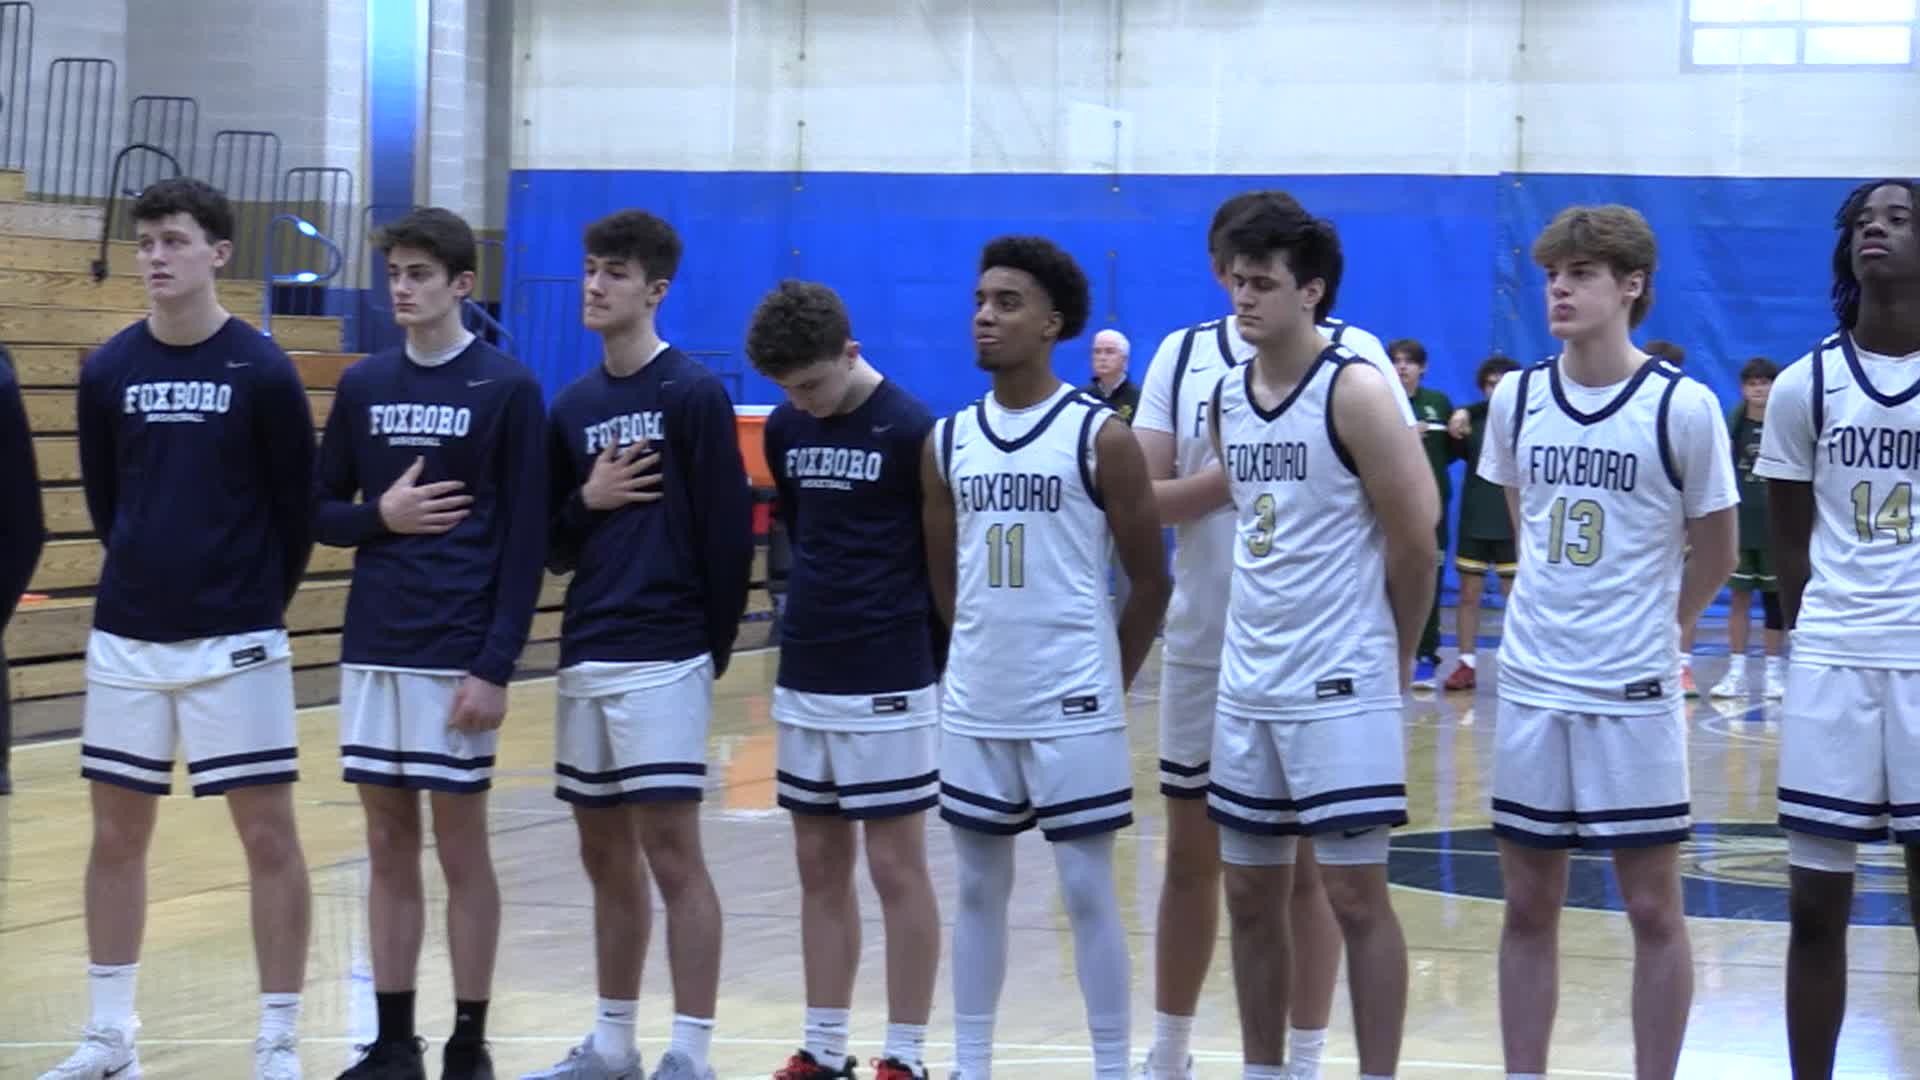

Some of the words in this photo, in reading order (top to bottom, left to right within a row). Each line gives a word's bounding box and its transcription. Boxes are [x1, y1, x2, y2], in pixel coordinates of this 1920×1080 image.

[124, 381, 232, 414] FOXBORO
[370, 403, 471, 437] FOXBORO
[785, 447, 882, 482] FOXBORO
[1226, 441, 1308, 482] FOXBORO
[1530, 445, 1638, 492] FOXBORO
[960, 473, 1062, 512] FOXBORO
[1850, 480, 1914, 545] 14
[1248, 493, 1276, 557] 3
[1548, 497, 1604, 567] 13
[985, 522, 1024, 588] 11
